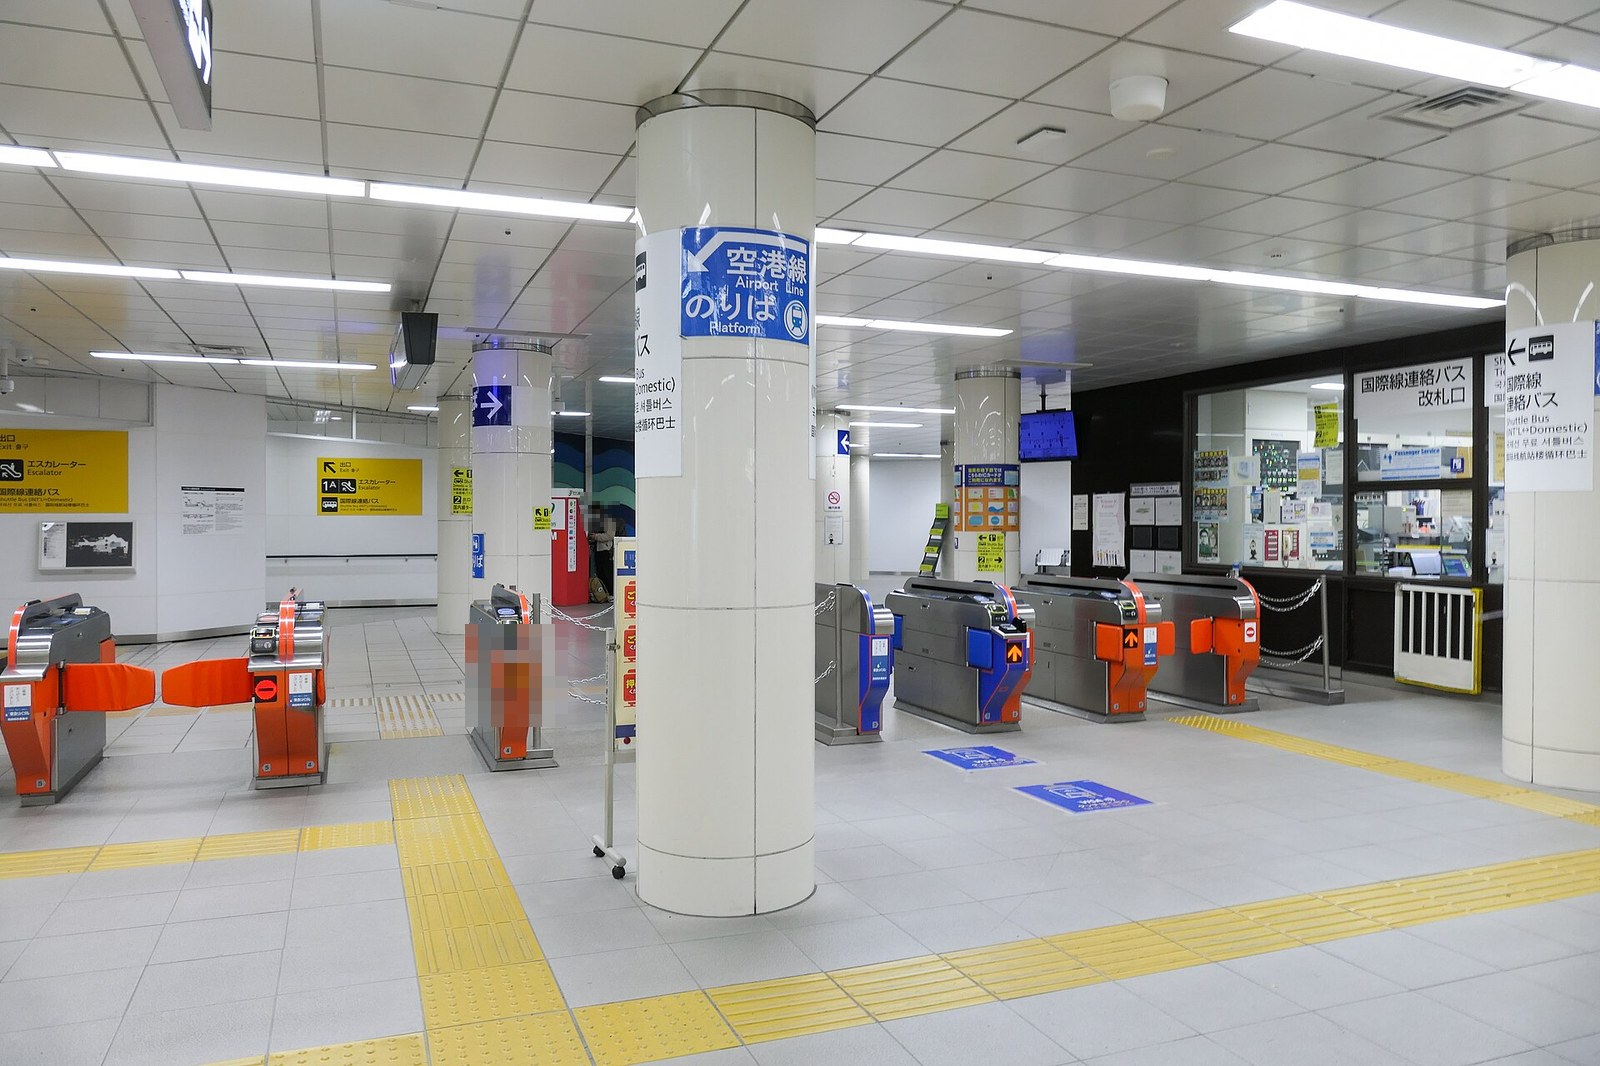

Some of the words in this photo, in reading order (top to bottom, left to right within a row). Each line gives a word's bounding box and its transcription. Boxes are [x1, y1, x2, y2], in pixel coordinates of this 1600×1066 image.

[727, 247, 807, 284] 空港線
[736, 276, 779, 292] Airport
[786, 283, 804, 297] Line
[685, 293, 777, 321] のりば
[710, 320, 762, 334] Platform
[1361, 365, 1466, 394] 国際線連絡バス
[1507, 371, 1542, 393] 国際線
[1418, 387, 1466, 407] 改札口
[1507, 392, 1559, 413] 連絡バス
[1531, 414, 1550, 424] Bus
[27, 460, 87, 469] エスカレーター
[0, 487, 60, 497] 国際線連絡バス
[323, 480, 337, 491] 1A
